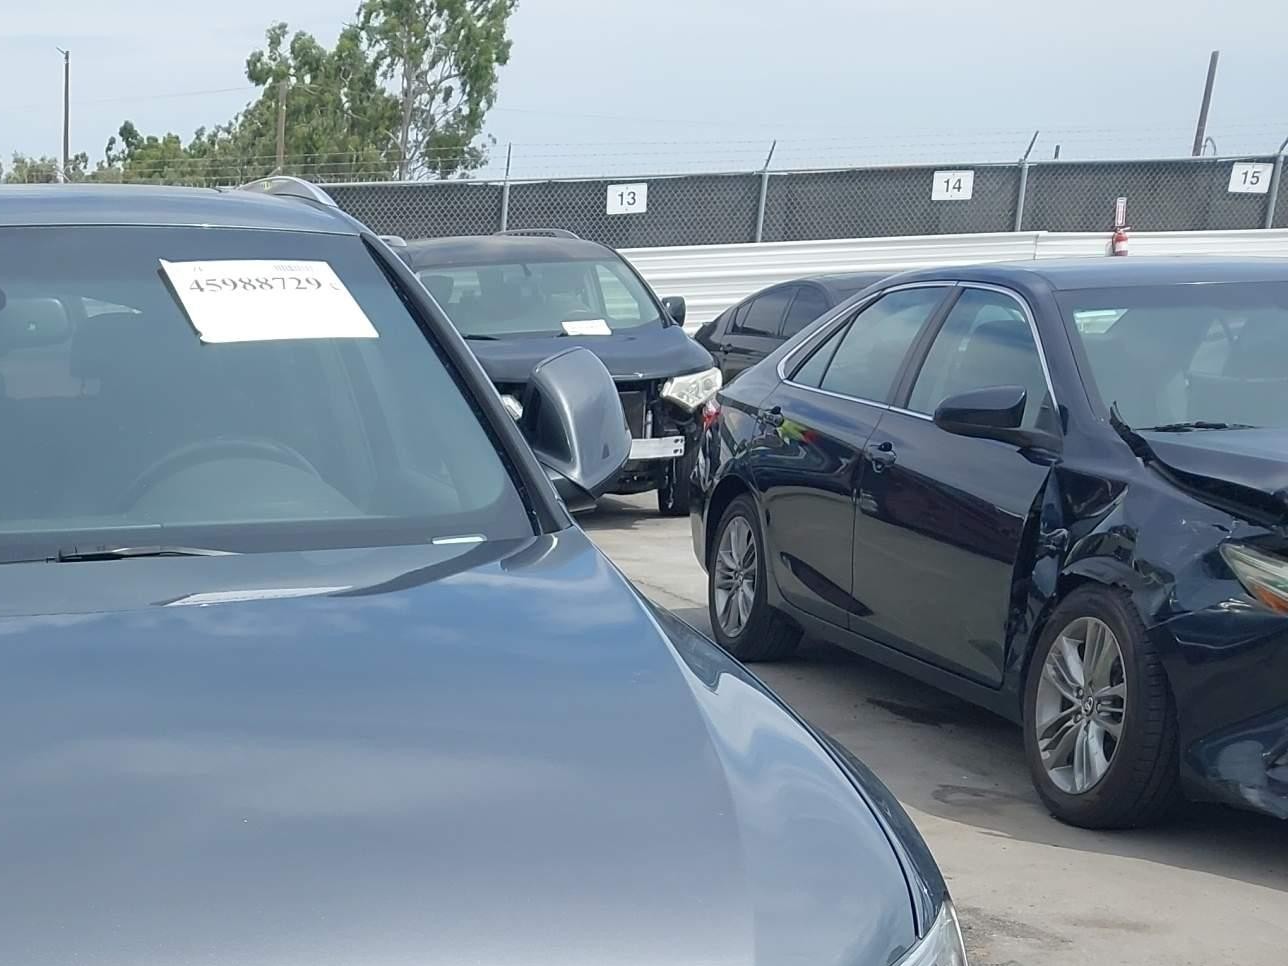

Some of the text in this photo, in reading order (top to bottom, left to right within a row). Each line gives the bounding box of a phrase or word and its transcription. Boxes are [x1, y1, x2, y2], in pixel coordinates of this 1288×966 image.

[943, 178, 962, 193] 14
[1241, 170, 1261, 186] 15
[617, 191, 636, 206] 13
[189, 277, 322, 292] 45988729
